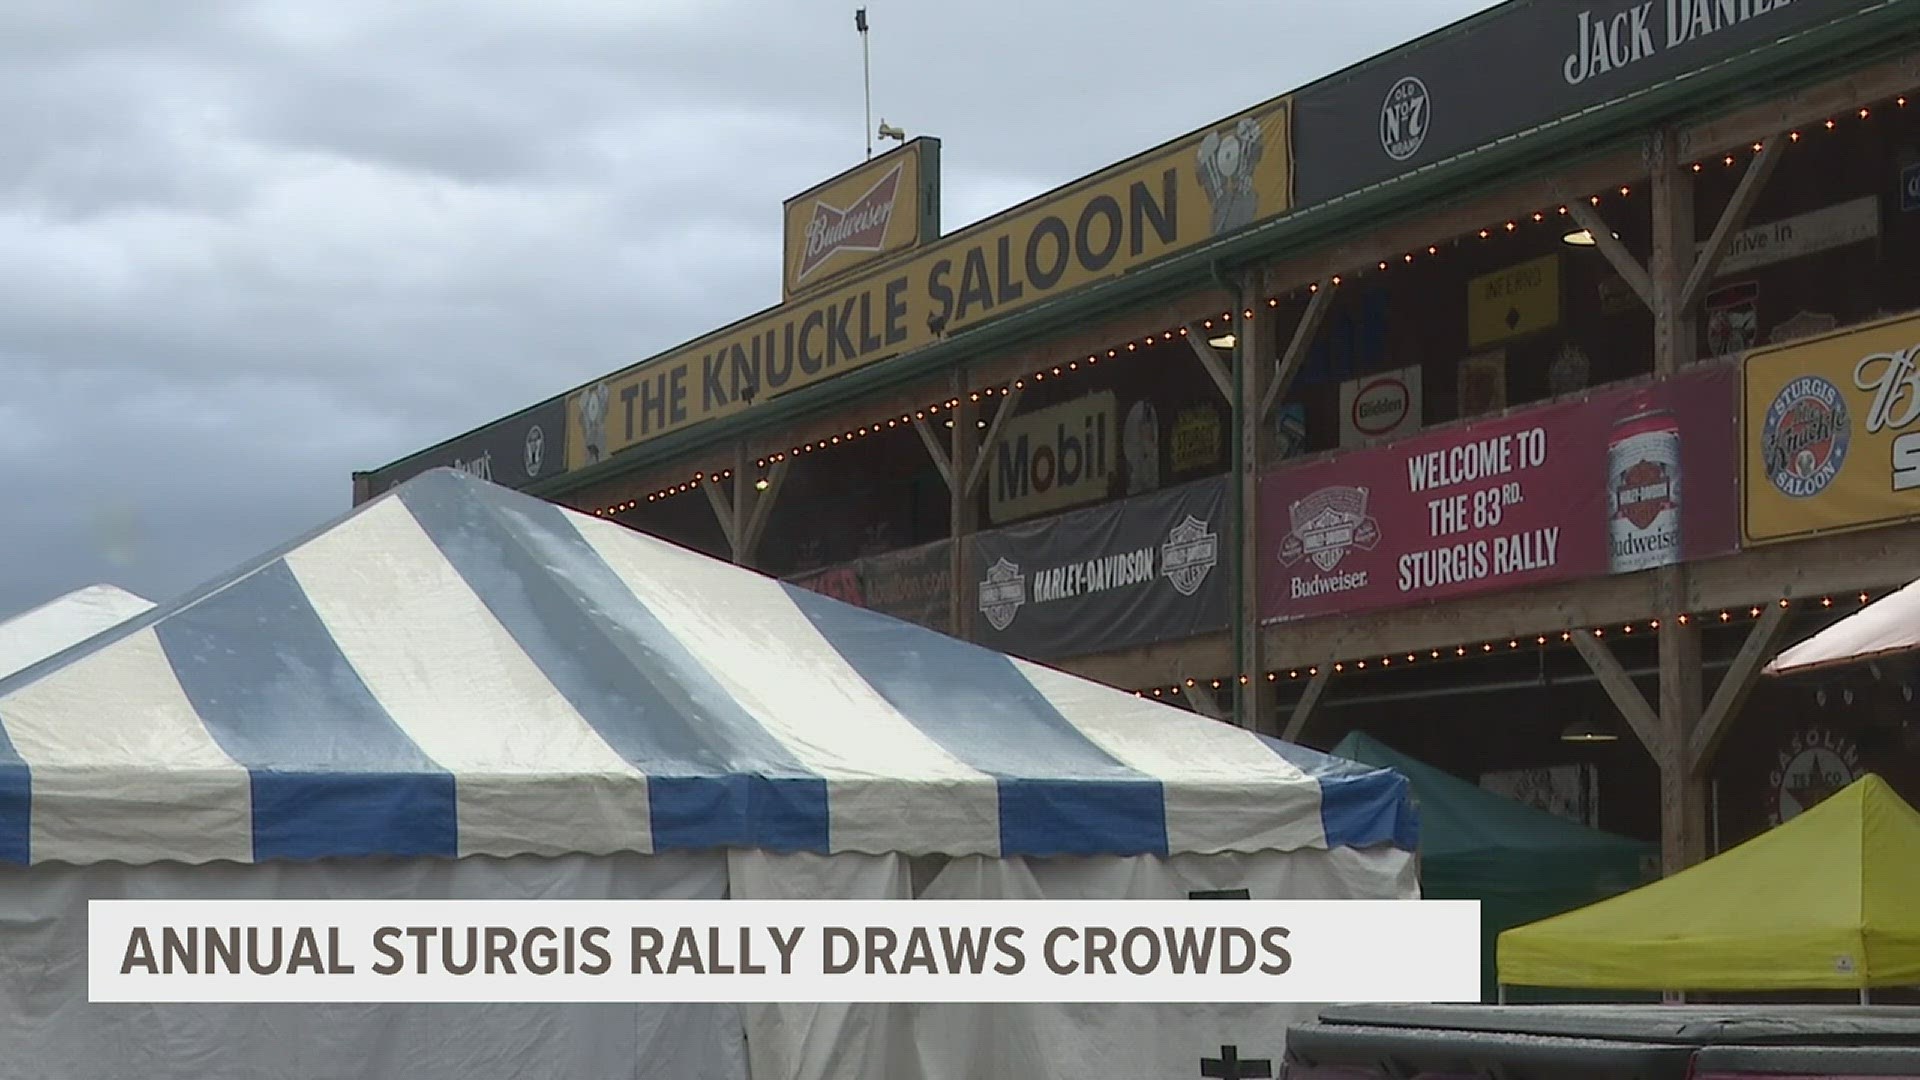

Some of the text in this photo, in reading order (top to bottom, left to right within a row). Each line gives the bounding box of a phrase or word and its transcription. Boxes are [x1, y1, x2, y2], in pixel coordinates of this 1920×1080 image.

[1564, 2, 1655, 85] JACK
[805, 201, 894, 256] Budweiser
[620, 167, 1177, 441] THE KNUCKLE SALOON
[1774, 378, 1837, 416] STURGIS
[998, 412, 1107, 502] Mobil
[1407, 427, 1546, 492] WELCOME TO
[1775, 460, 1837, 496] SALOON
[1428, 494, 1469, 537] THE
[1032, 546, 1155, 603] HARLEY-DAVIDSON
[1397, 526, 1559, 592] STURGIS RALLY
